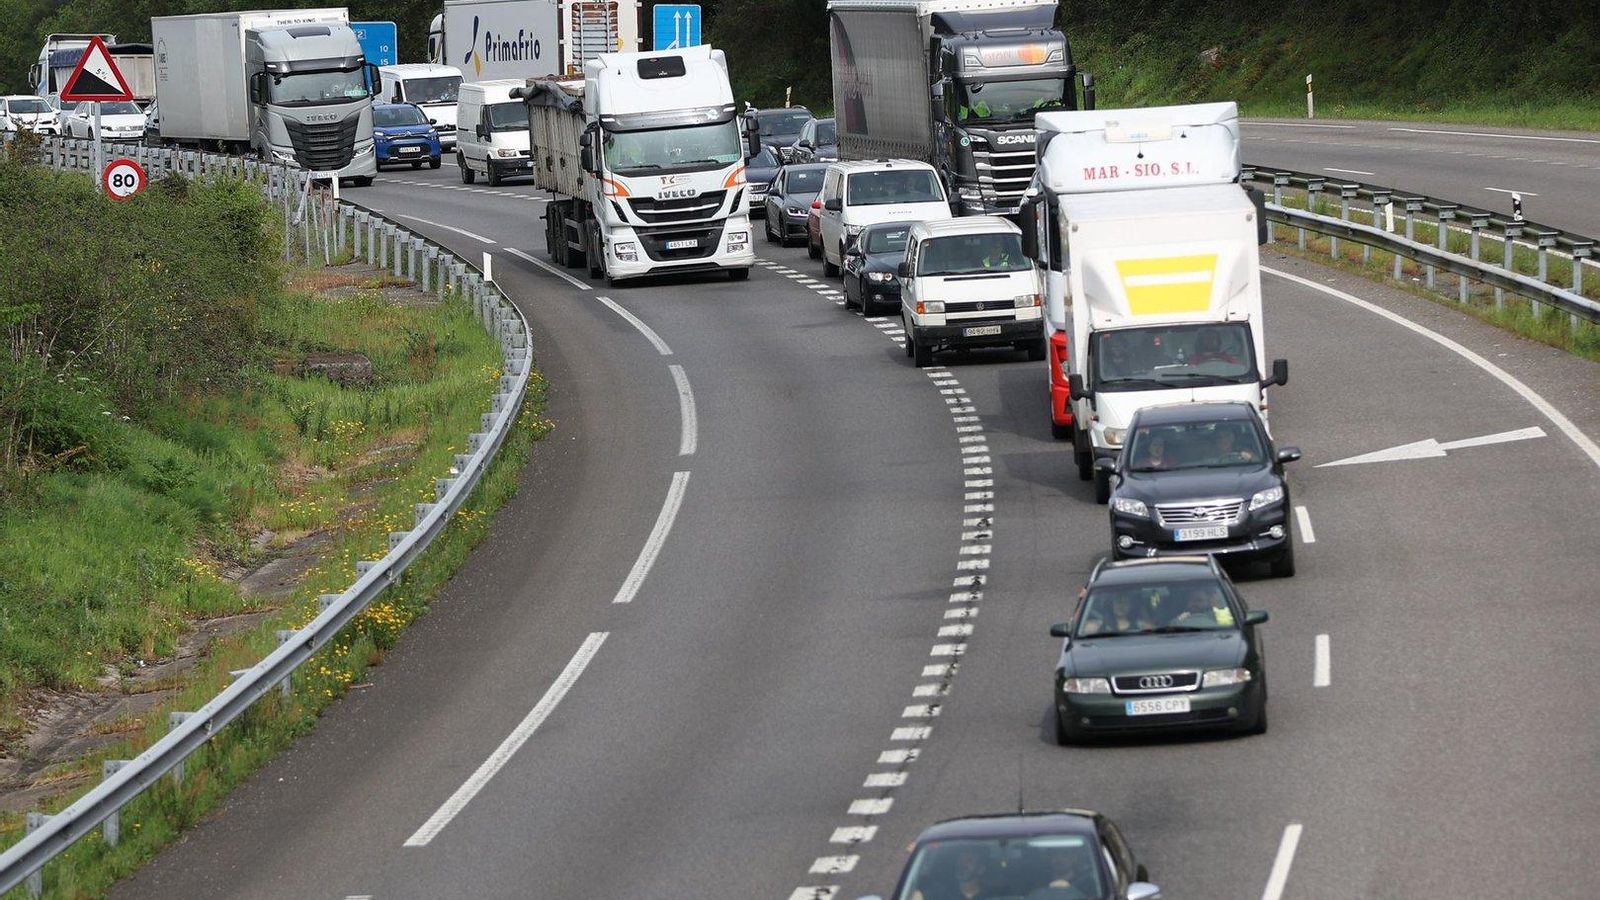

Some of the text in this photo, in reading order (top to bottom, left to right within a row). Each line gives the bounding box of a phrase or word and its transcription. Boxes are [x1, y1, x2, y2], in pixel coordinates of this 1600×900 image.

[379, 45, 389, 53] 10
[1083, 165, 1119, 180] MAR
[112, 173, 135, 188] 80
[658, 189, 696, 199] IVECO
[1207, 527, 1226, 537] HLS
